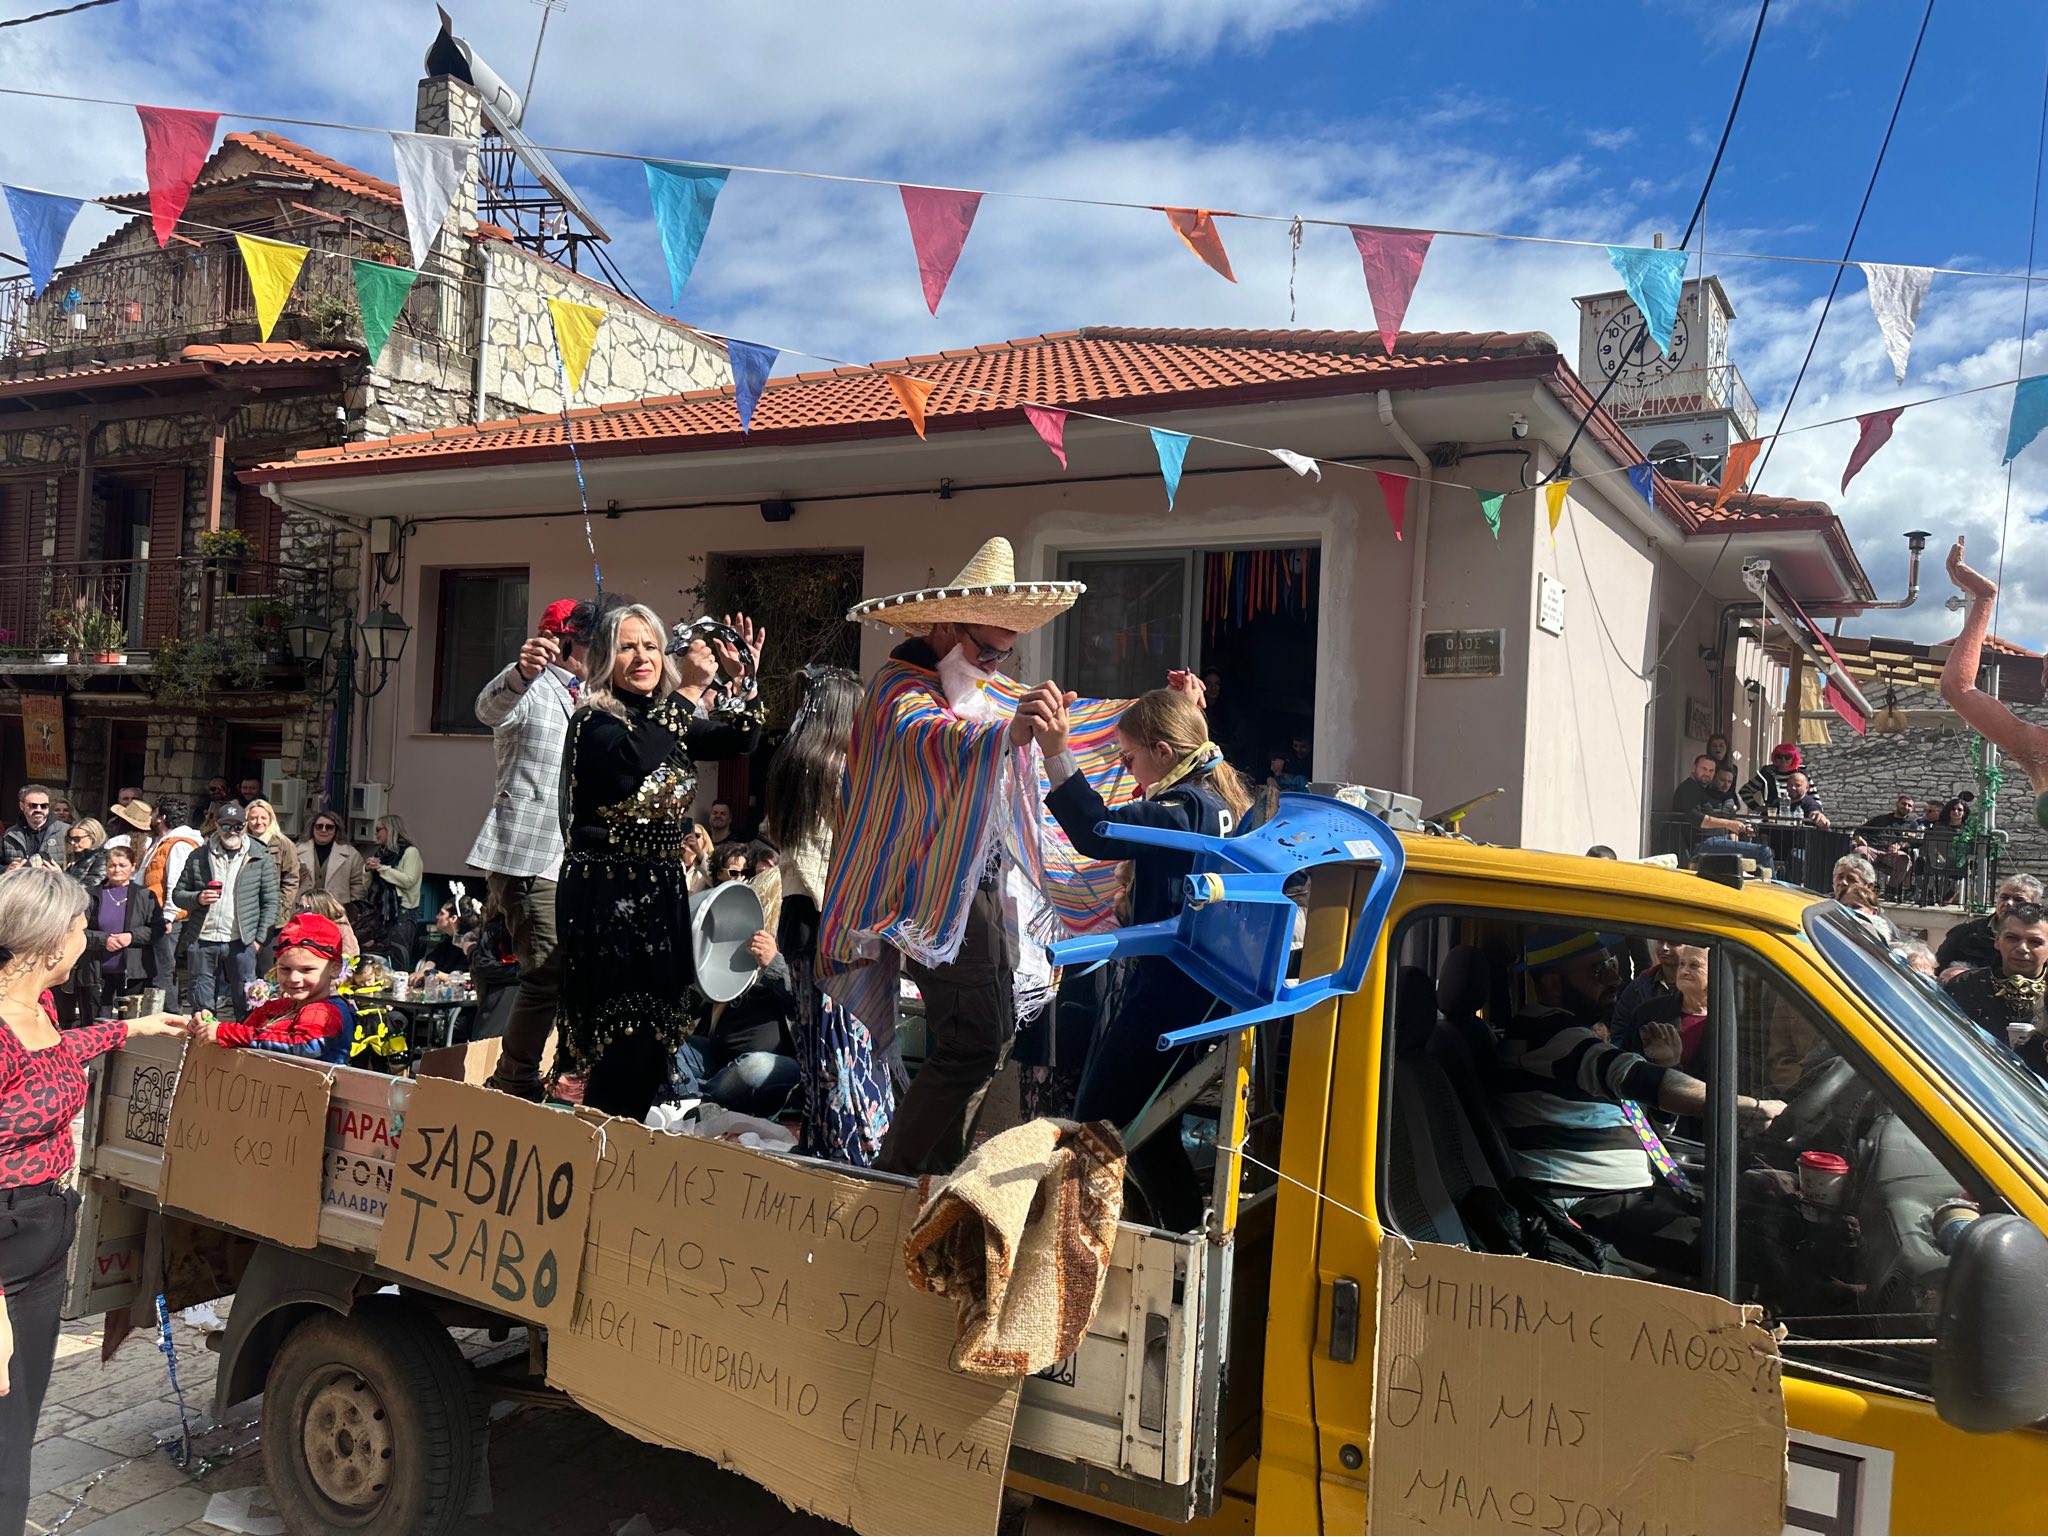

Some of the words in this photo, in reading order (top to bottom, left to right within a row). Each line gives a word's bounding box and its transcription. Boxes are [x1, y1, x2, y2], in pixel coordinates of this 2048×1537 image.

[1602, 344, 1612, 355] 9
[1607, 360, 1616, 371] 8
[1608, 327, 1620, 339] 10
[1668, 352, 1677, 363] 4
[1674, 335, 1683, 346] 3
[1446, 637, 1481, 650] ΟΔΟΣ
[1218, 809, 1233, 839] P
[181, 1059, 311, 1127] ΑΥΤΟΤΗΤΑ
[322, 1186, 389, 1218] ΑΛΑΒΡΥ
[407, 1123, 574, 1226] ΣΑΒΙΛΟ
[592, 1139, 636, 1192] ΘΑ
[657, 1160, 724, 1208] ΛΕΣ
[400, 1187, 558, 1309] ΤΣΑΒΟ
[626, 1227, 790, 1325] ΓΛΩΣΣΑ
[825, 1292, 899, 1354] ΣΟΥ
[1390, 1274, 1606, 1349] ΜΠΗΚΑΜΕ
[569, 1290, 637, 1353] ΠΑΘΕΙ
[653, 1321, 819, 1417] ΤΡΙΤΟΒΑΘΜΙΟ
[841, 1398, 993, 1475] ΕΓΚΑΥΜΑ
[1387, 1353, 1458, 1428] ΘΑ
[1490, 1395, 1592, 1448] ΜΑΣ
[1404, 1468, 1669, 1537] ΜΑΛΩΣΟΥ
